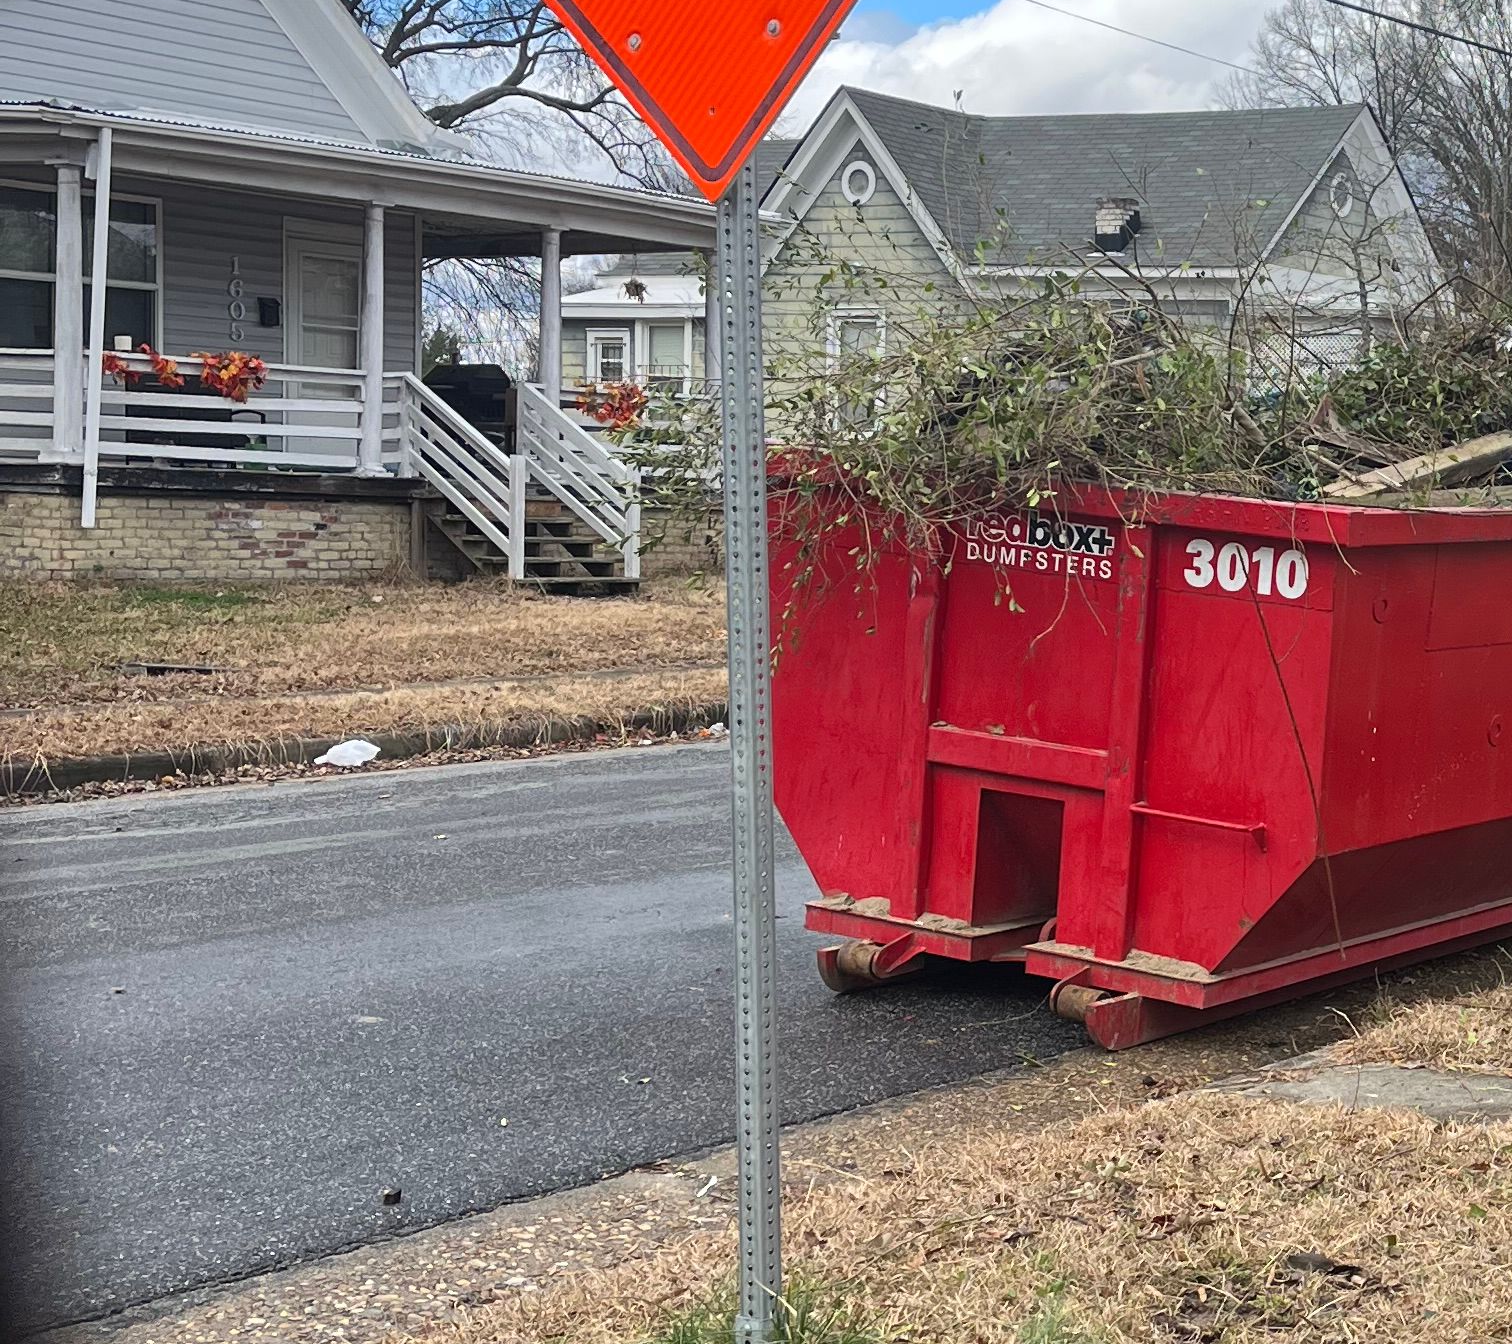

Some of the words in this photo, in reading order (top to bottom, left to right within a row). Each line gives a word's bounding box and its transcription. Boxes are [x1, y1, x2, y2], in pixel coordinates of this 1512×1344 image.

[229, 256, 246, 343] 1605
[966, 541, 1112, 579] DUMPSTERS
[1183, 538, 1309, 599] 3010
